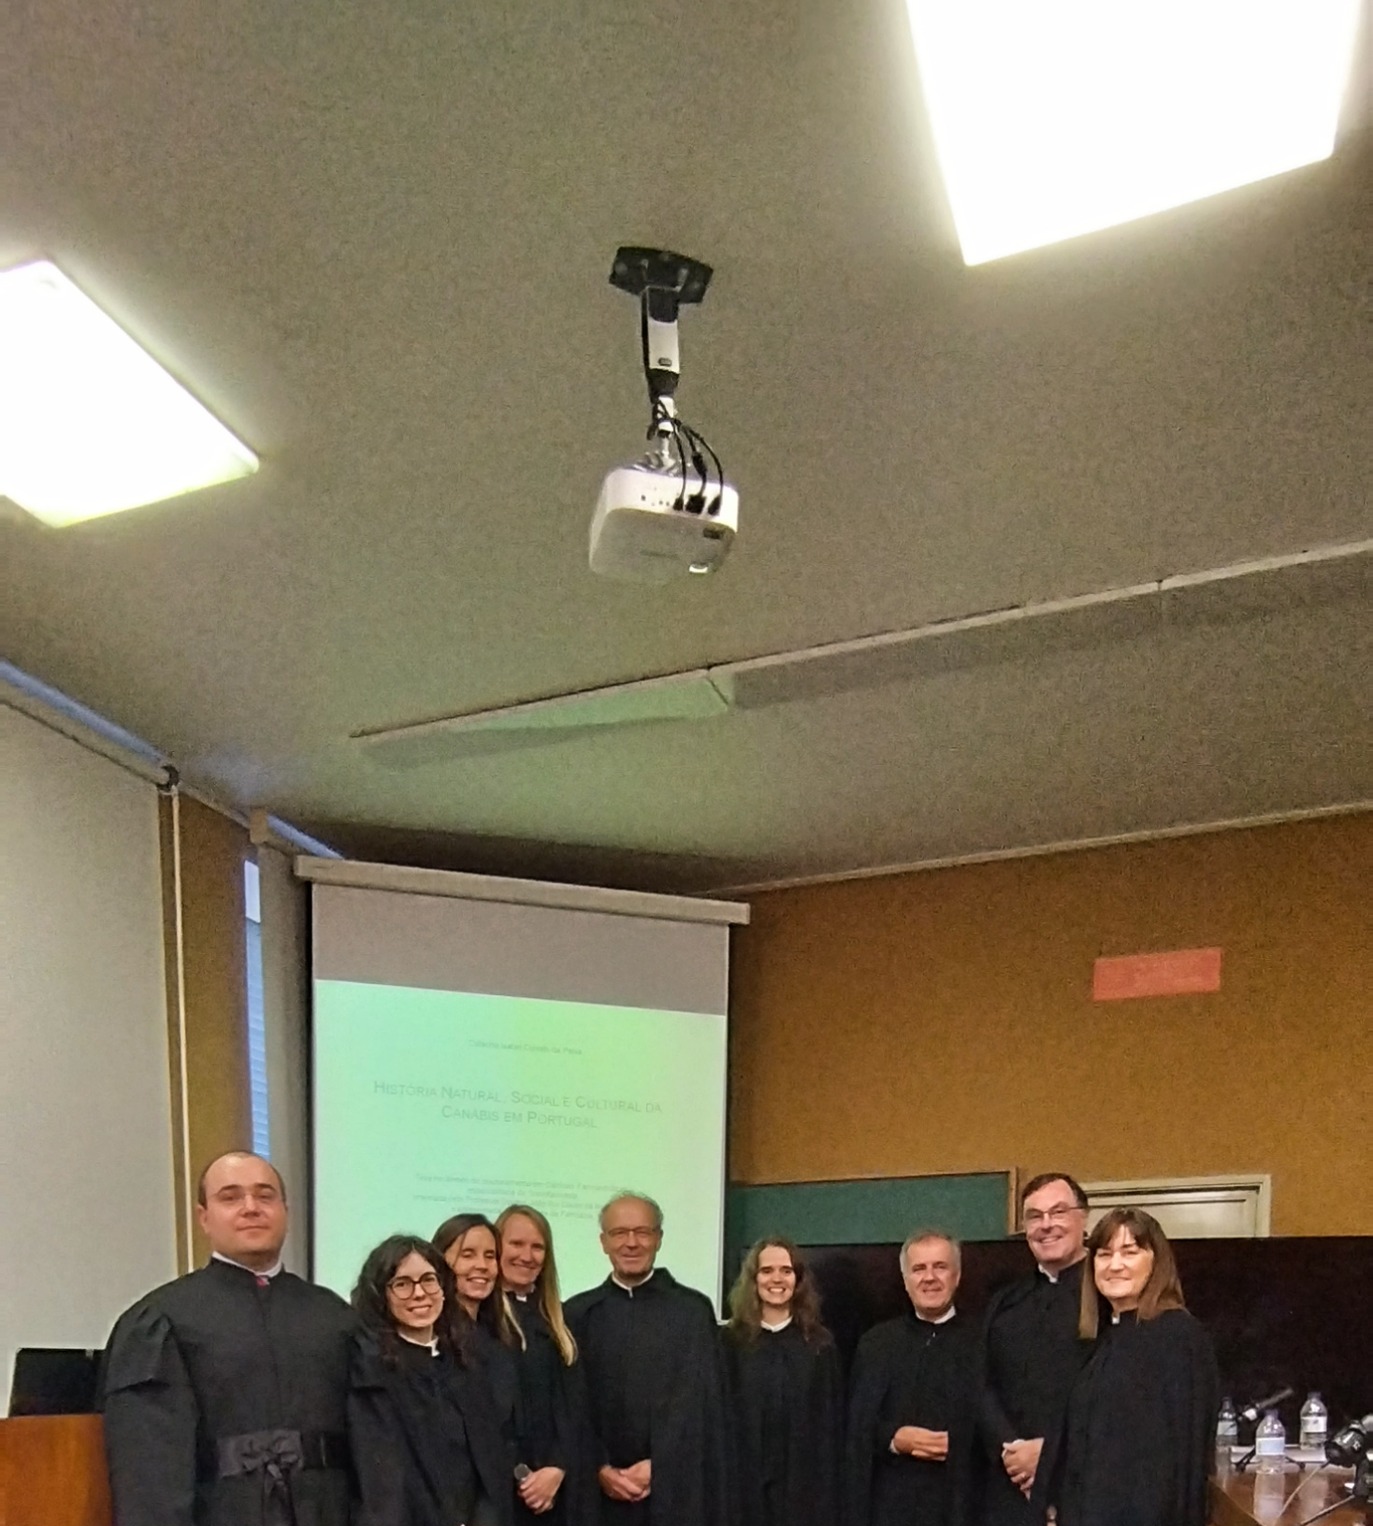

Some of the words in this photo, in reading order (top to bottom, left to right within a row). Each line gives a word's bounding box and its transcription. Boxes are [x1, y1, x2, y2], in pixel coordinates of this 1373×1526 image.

[511, 1090, 559, 1107] SOCIAL
[562, 1096, 571, 1107] E
[575, 1096, 641, 1113] CULTURAL
[645, 1102, 663, 1113] DA
[503, 1111, 522, 1123] EM
[527, 1111, 598, 1128] PORTUGAL
